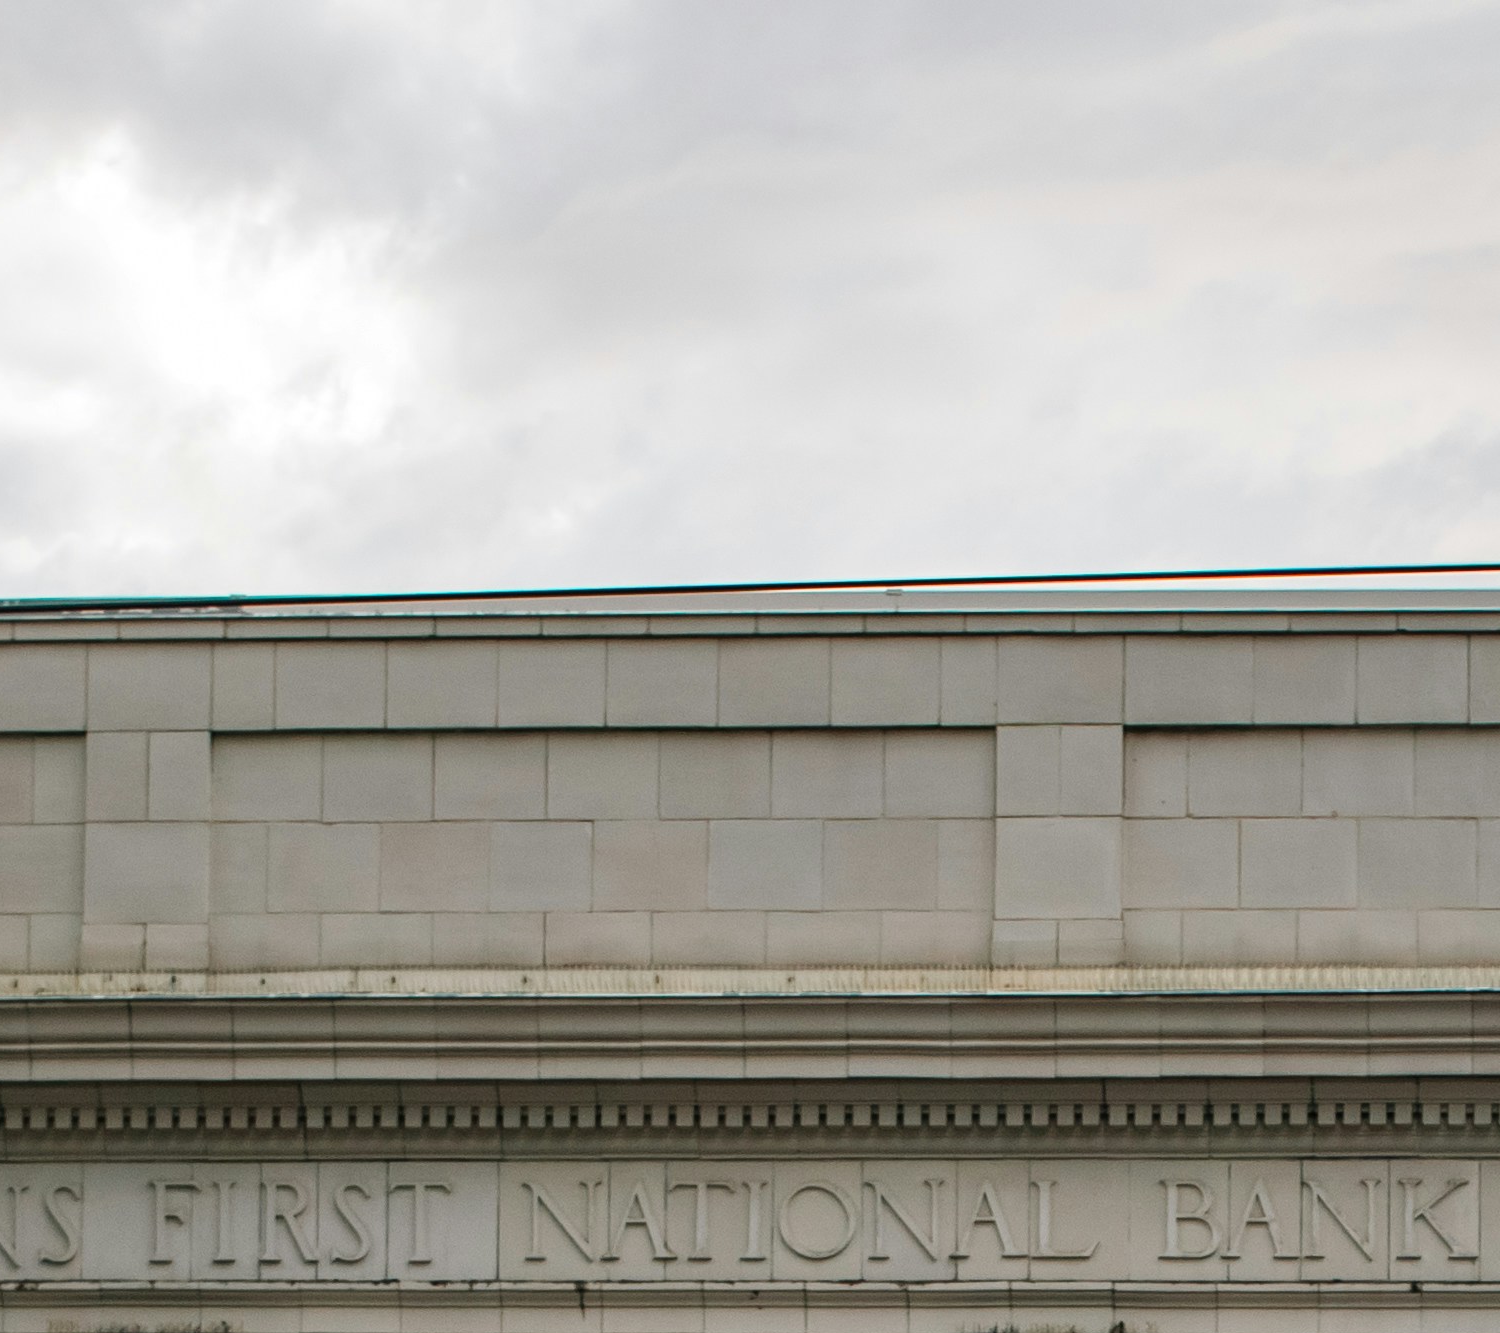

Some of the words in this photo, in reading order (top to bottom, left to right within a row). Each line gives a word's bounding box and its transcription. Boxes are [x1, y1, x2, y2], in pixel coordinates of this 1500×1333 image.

[147, 1181, 453, 1267] FIRST
[524, 1177, 1100, 1264] NATIONAL
[1157, 1177, 1480, 1264] BANK
